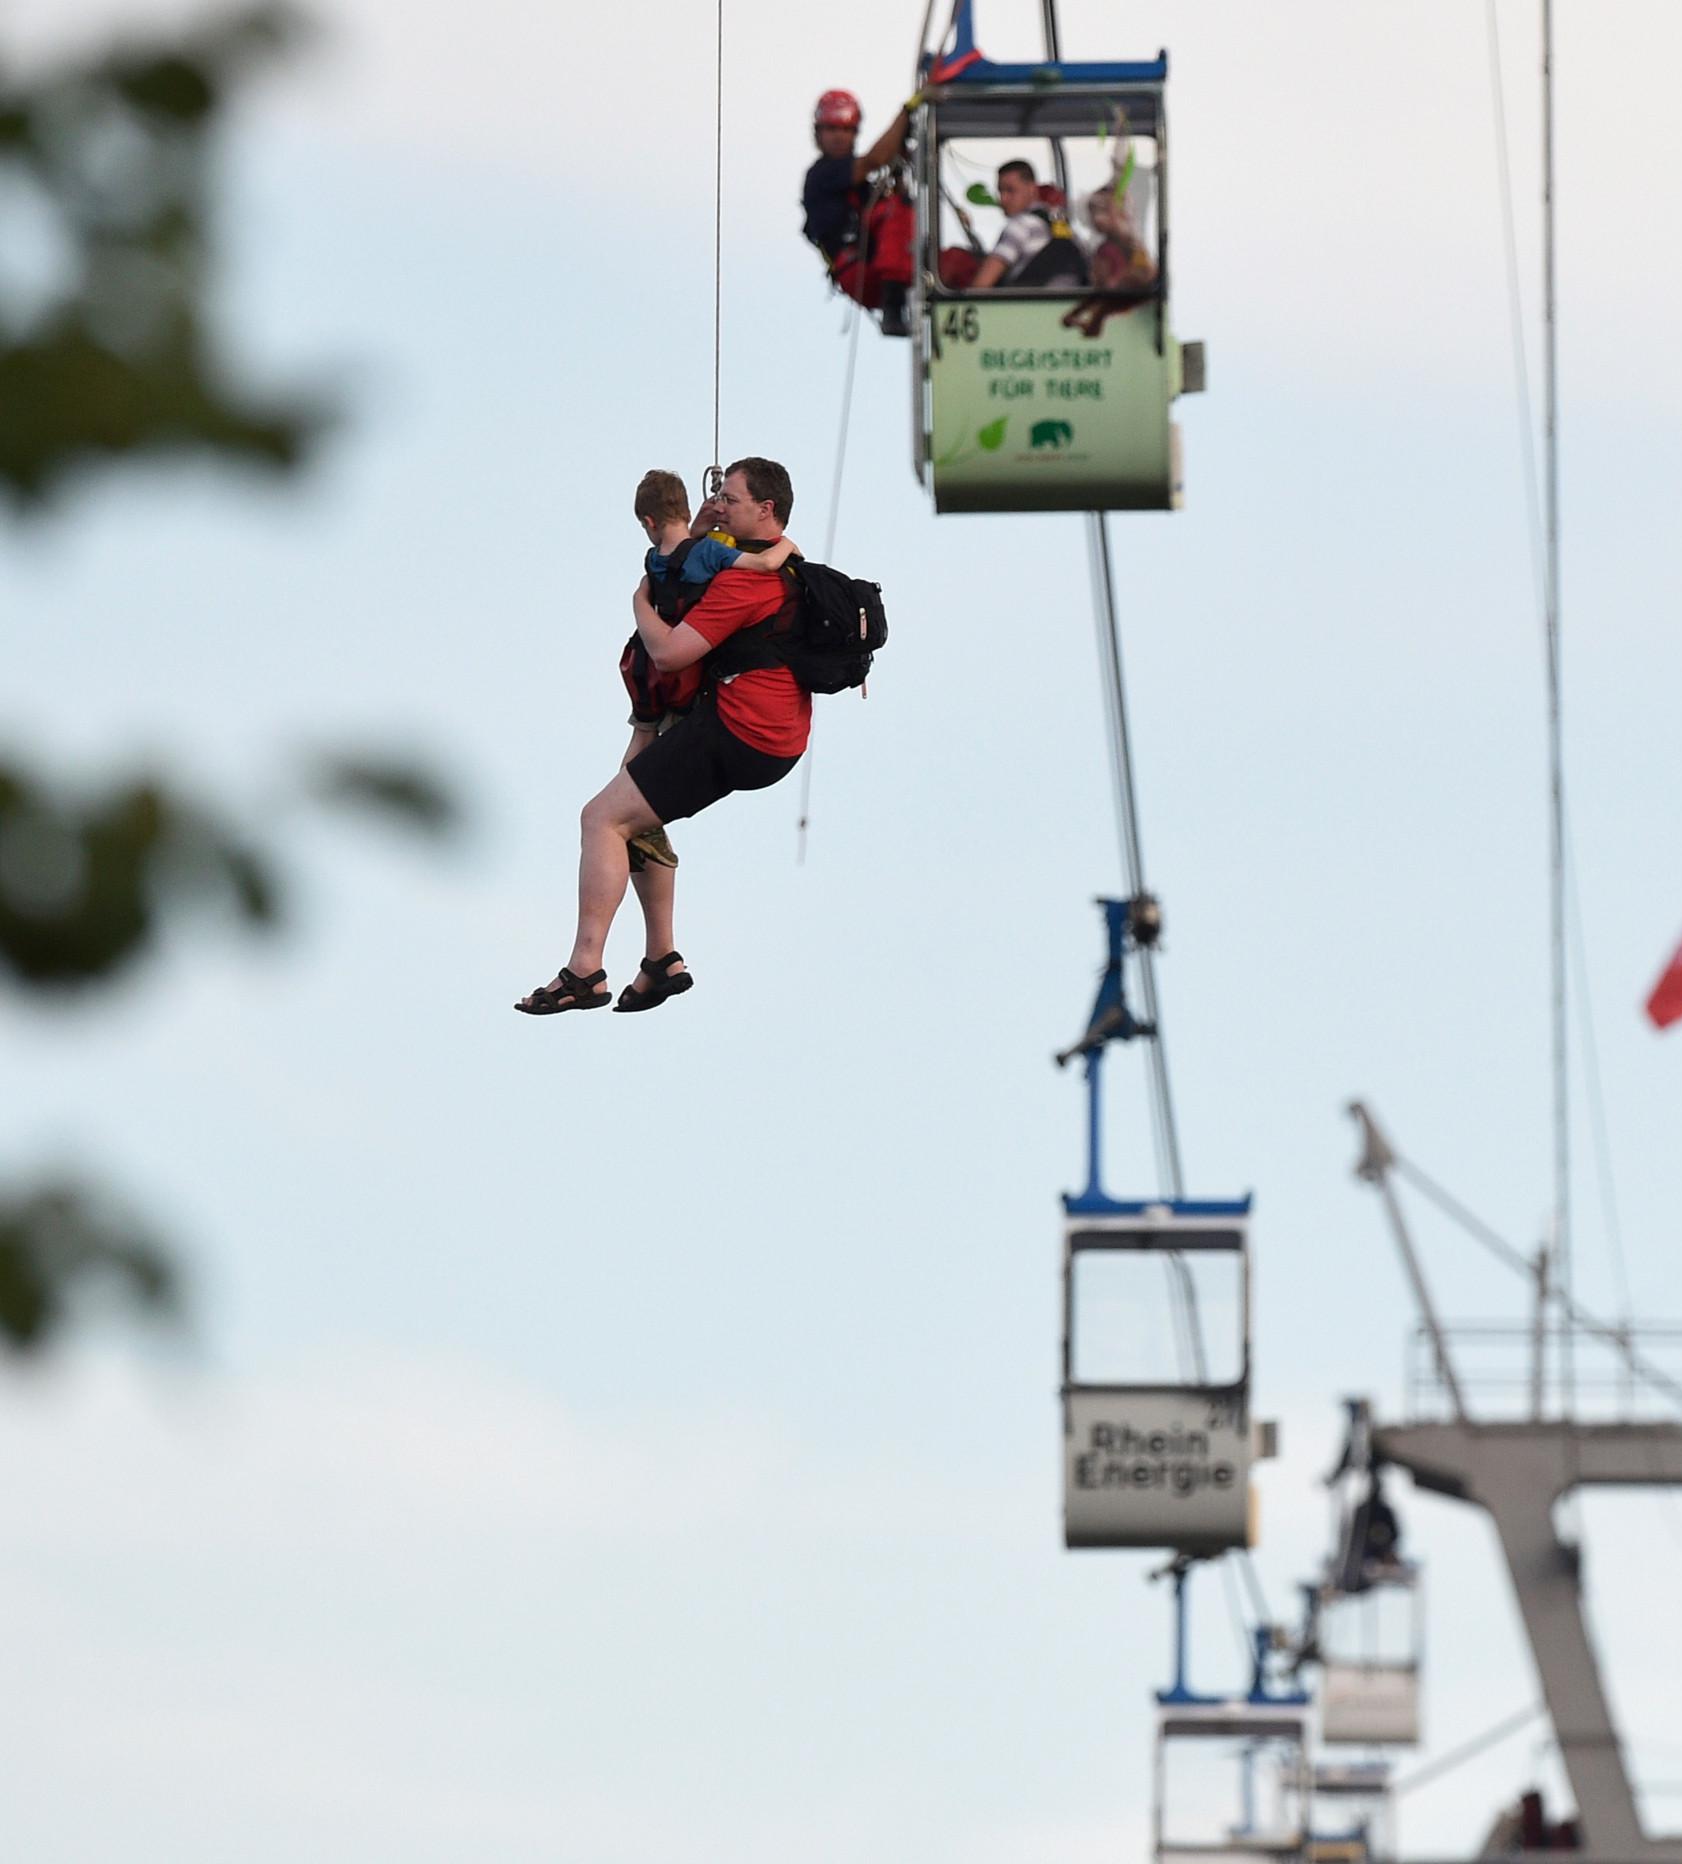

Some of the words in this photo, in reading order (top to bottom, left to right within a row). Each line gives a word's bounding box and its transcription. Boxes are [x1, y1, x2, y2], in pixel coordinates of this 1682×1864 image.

[942, 305, 980, 342] 46
[980, 349, 1112, 370] BEGEISTERT
[989, 374, 1034, 399] FÜR
[1046, 379, 1103, 400] TIERE
[1091, 1420, 1208, 1454] Rhein
[1076, 1450, 1235, 1499] Energie
